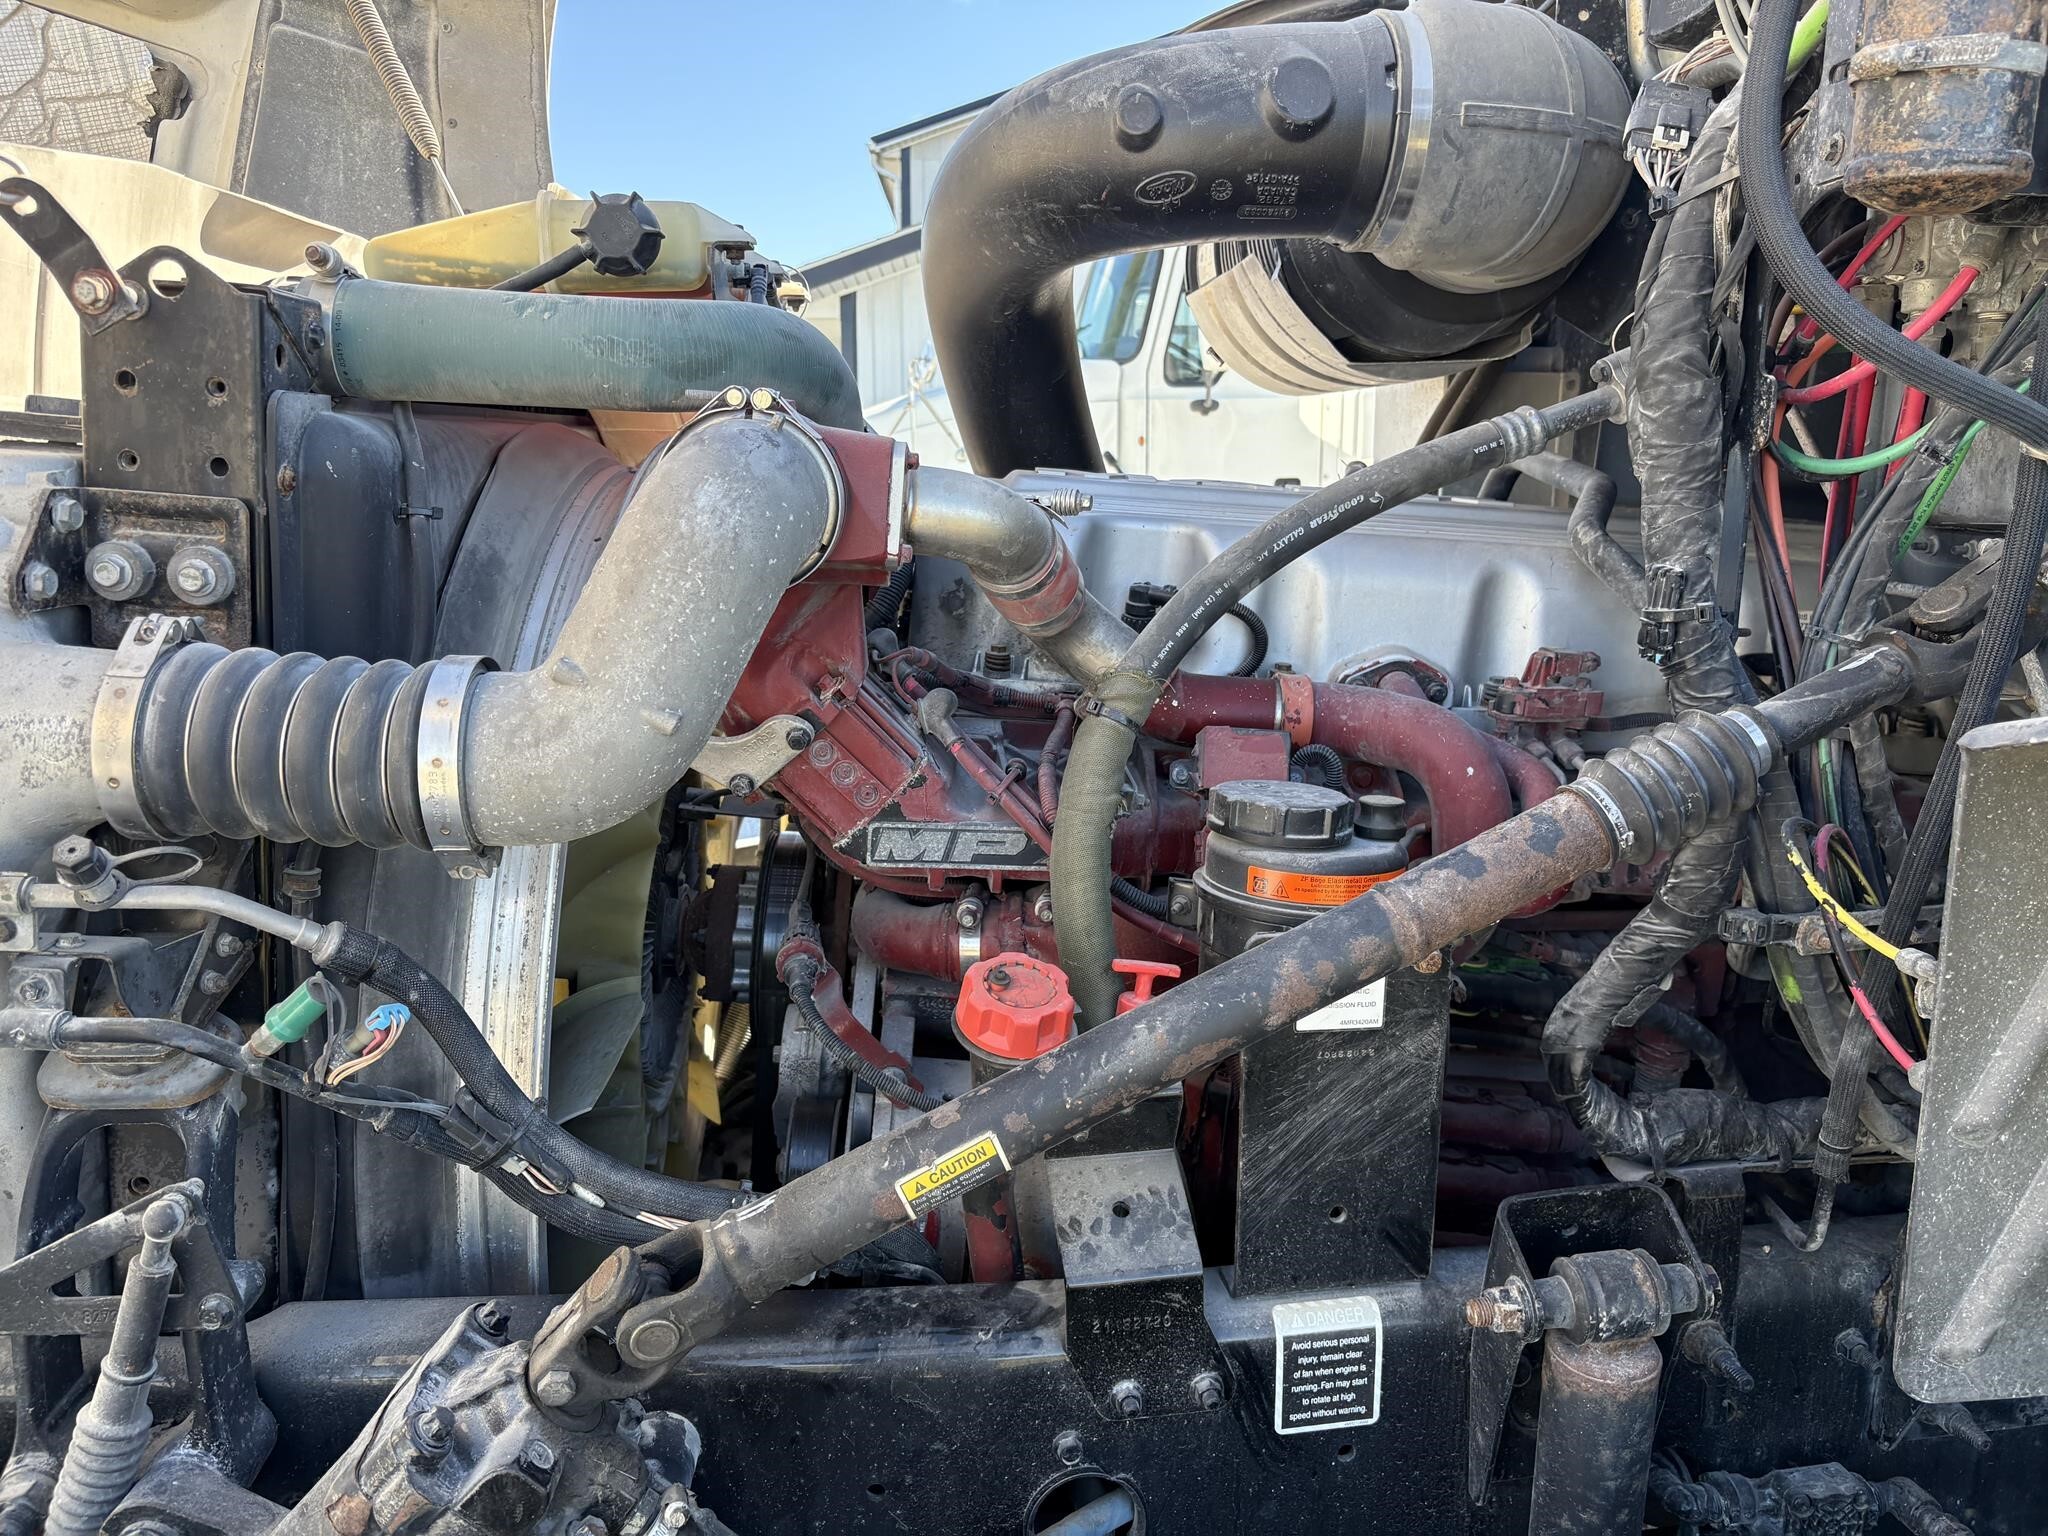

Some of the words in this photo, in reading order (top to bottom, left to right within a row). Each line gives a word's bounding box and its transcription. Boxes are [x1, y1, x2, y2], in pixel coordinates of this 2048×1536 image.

[1473, 444, 1488, 454] USA
[1310, 494, 1364, 529] GOODYEAR
[1273, 527, 1305, 553] GALAXY
[1256, 551, 1269, 562] A/C
[1160, 640, 1174, 661] MADE
[929, 1145, 988, 1184] CAUTION
[912, 1194, 927, 1207] This
[927, 1183, 951, 1198] vehicle
[960, 1161, 991, 1182] equipped
[915, 1201, 930, 1212] with
[930, 1194, 941, 1204] the
[942, 1185, 962, 1197] Mack
[1306, 1306, 1365, 1326] DANGER
[1291, 1340, 1312, 1351] Avoid
[1312, 1338, 1338, 1348] serious
[1339, 1334, 1370, 1346] personal
[1320, 1352, 1345, 1362] remain
[1345, 1350, 1364, 1359] clear
[1293, 1371, 1301, 1379] of
[1301, 1369, 1314, 1378] fan
[1314, 1366, 1334, 1376] when
[1335, 1365, 1359, 1375] engine
[1359, 1363, 1367, 1371] is
[1291, 1383, 1321, 1393] running.
[1321, 1381, 1335, 1390] Fan
[1335, 1379, 1351, 1389] may
[1351, 1377, 1368, 1386] start
[1310, 1395, 1331, 1405] rotate
[1332, 1394, 1340, 1402] at
[1340, 1392, 1356, 1401] high
[1289, 1410, 1311, 1421] speed
[1312, 1407, 1337, 1418] without
[1338, 1405, 1368, 1415] warning.
